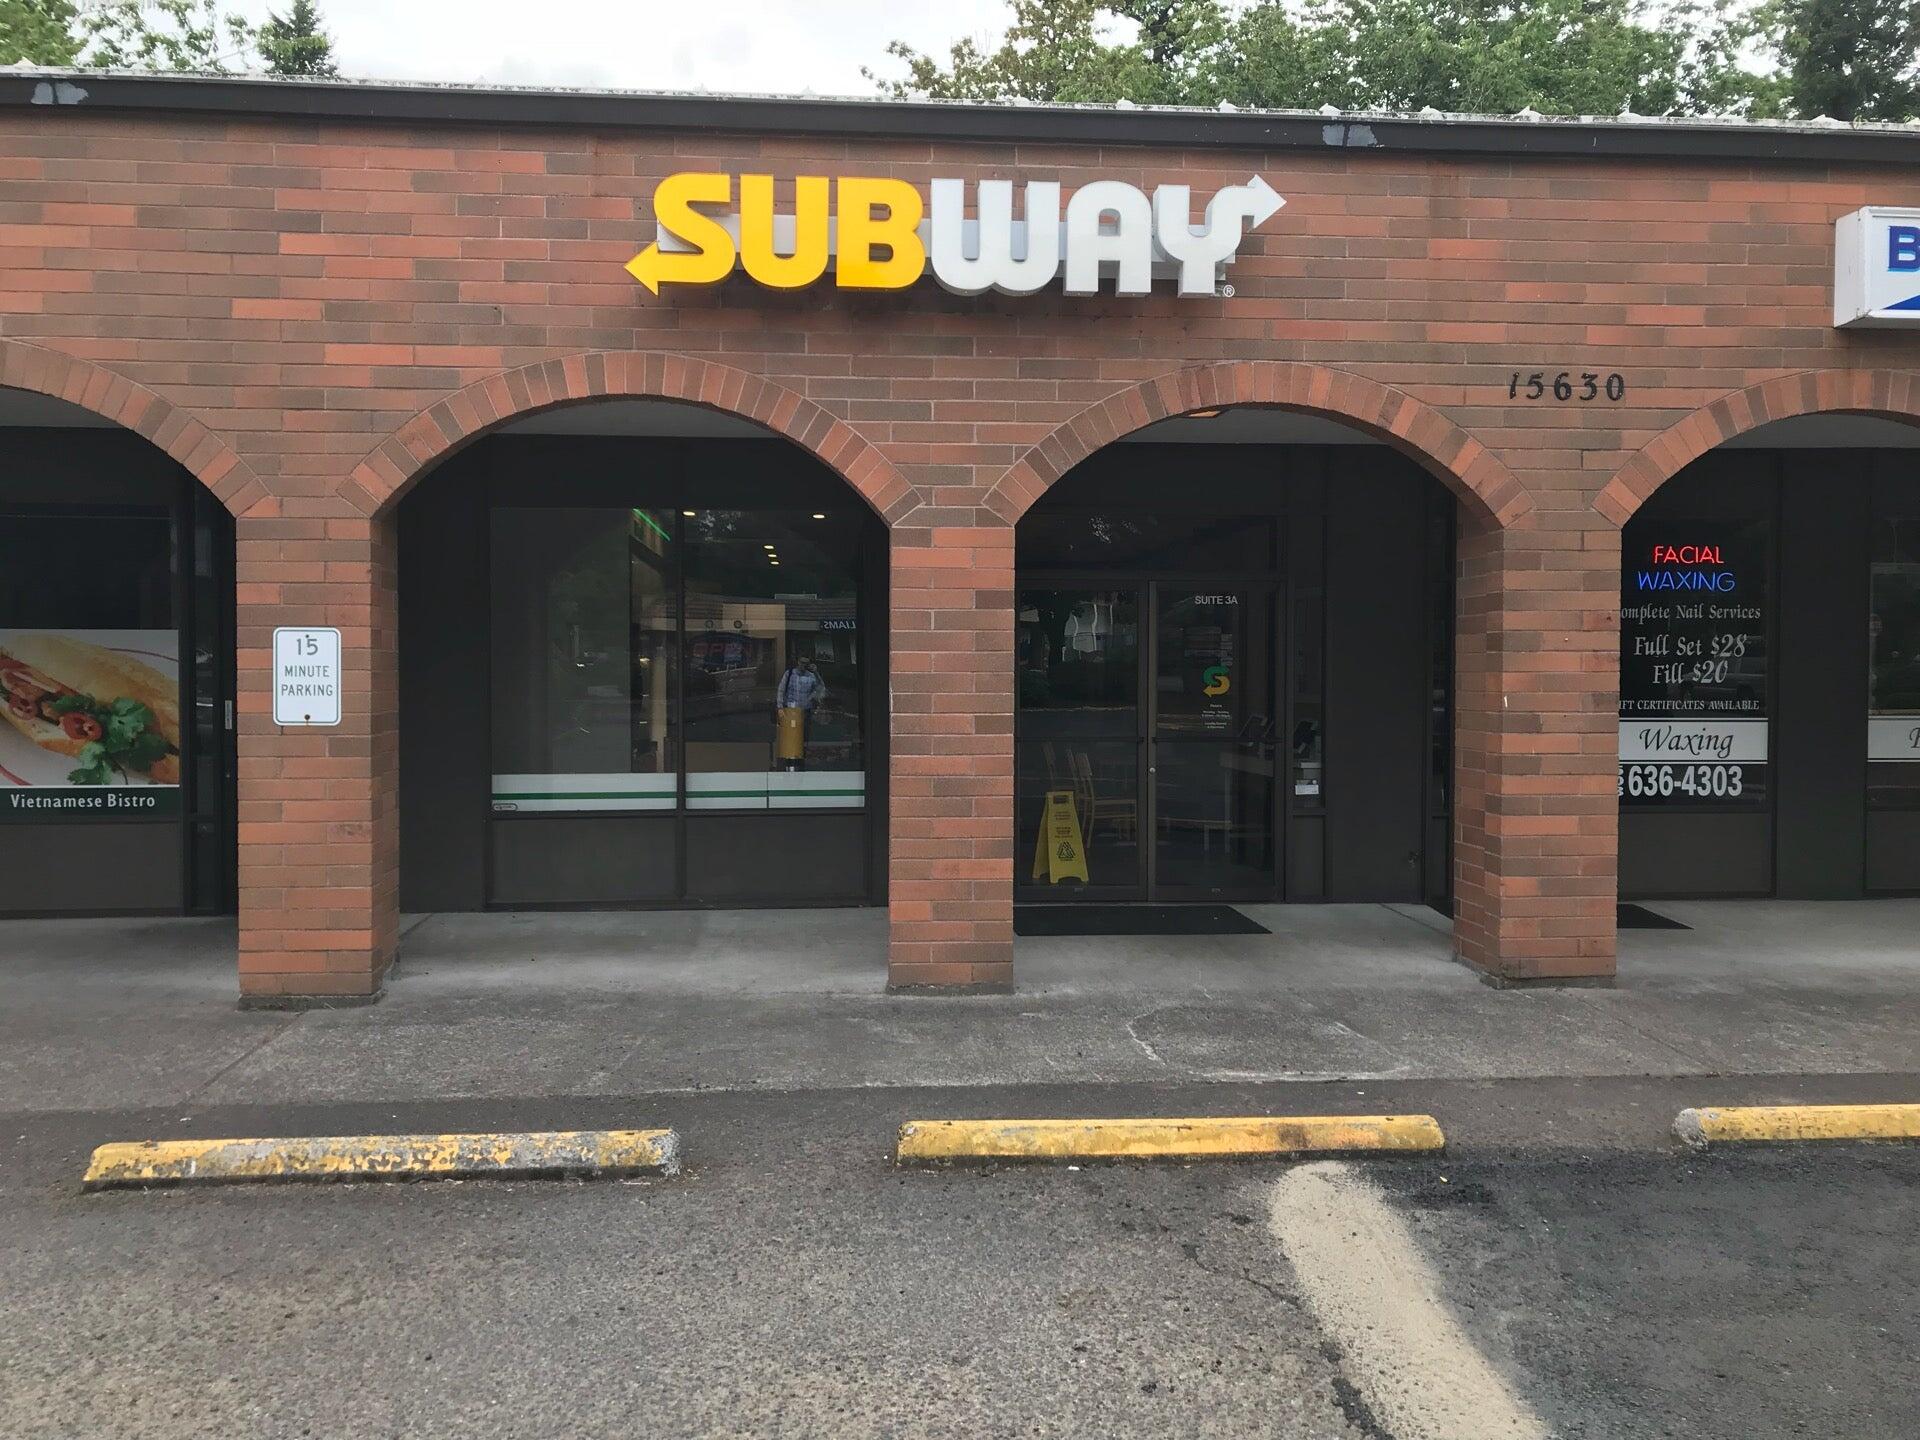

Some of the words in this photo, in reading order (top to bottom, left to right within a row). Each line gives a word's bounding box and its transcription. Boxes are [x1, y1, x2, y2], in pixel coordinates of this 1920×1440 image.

[623, 172, 1287, 297] SUBWAY
[1509, 372, 1624, 401] 15630
[1653, 545, 1725, 564] FACIAL
[1637, 570, 1736, 592] WAXING
[1194, 595, 1224, 605] SUITE
[1225, 595, 1239, 605] 3A
[1621, 603, 1671, 625] omplete
[1676, 603, 1704, 619] Nail
[1708, 604, 1761, 619] Services
[296, 638, 319, 656] 15
[1633, 634, 1670, 656] Full
[1676, 636, 1703, 656] Set
[1710, 633, 1748, 658] $28
[284, 665, 330, 677] MINUTE
[1652, 662, 1685, 684] Fill
[1692, 660, 1729, 684] $20
[281, 684, 333, 696] PARKING
[1618, 700, 1635, 710] IFT
[1637, 699, 1705, 710] CERTIFICATES
[1708, 699, 1760, 710] AVAILABLE
[1639, 725, 1734, 759] Waxing
[1627, 765, 1743, 797] 636-4303
[10, 793, 102, 808] Vietnamese
[107, 793, 156, 808] Bistro
